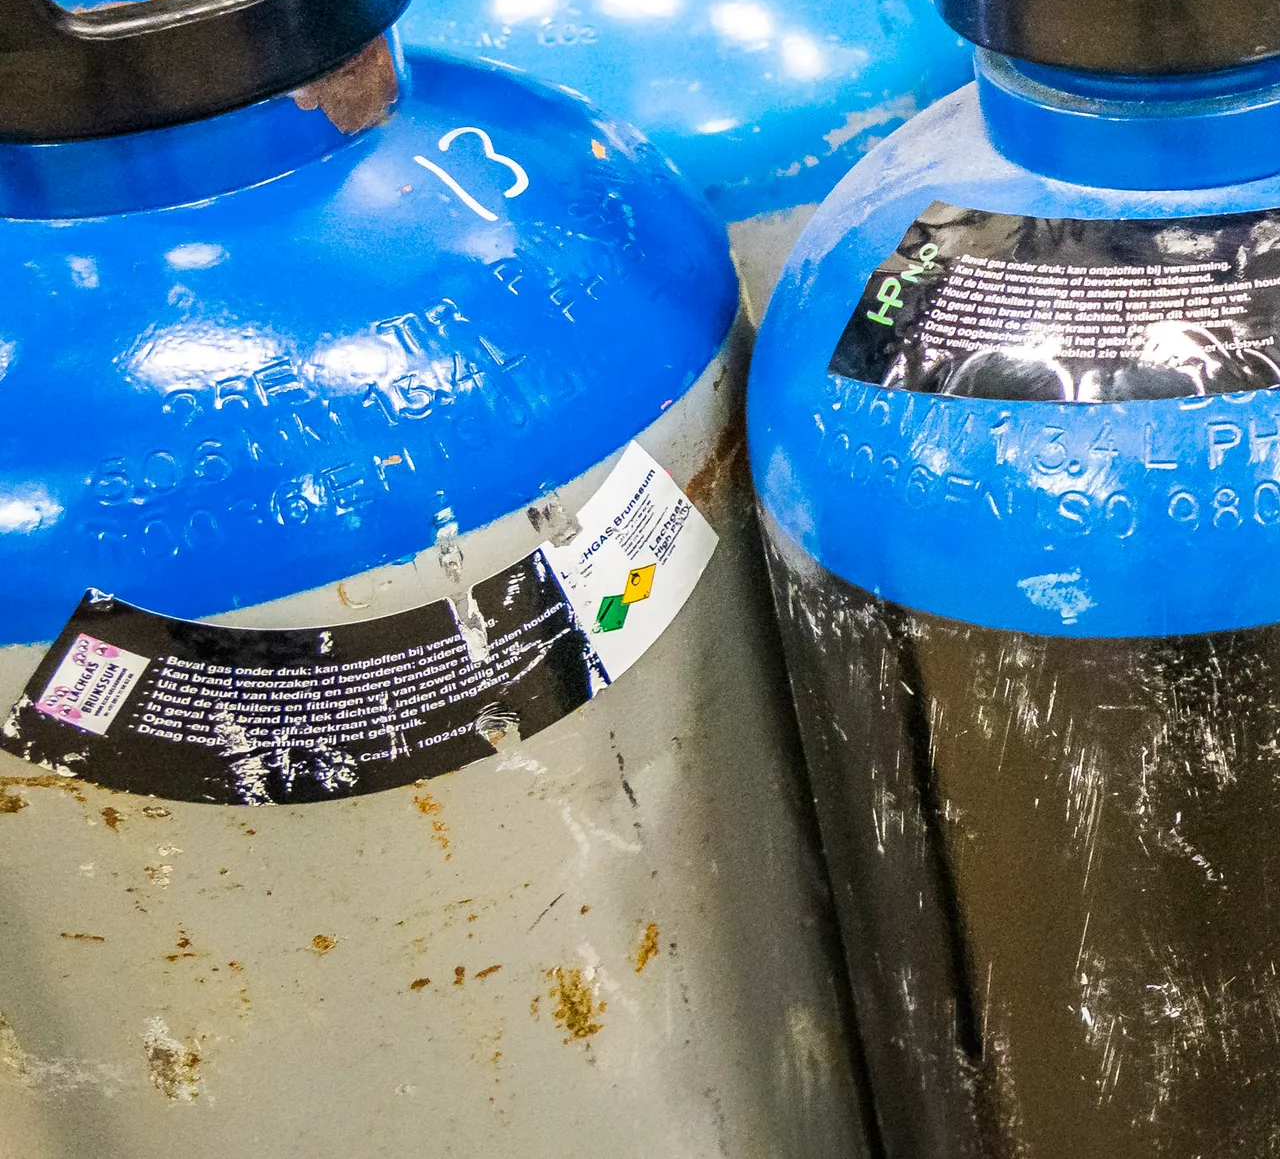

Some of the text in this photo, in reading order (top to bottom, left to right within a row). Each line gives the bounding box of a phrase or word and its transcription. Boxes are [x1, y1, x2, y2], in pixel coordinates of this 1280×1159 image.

[413, 126, 530, 222] 13
[953, 265, 1214, 287] Kan brand veroorzaken bevorderen; oxiderend.
[988, 259, 1231, 277] gas onder kan ontploffen bij verwarming.
[867, 277, 904, 326] HP
[942, 287, 1184, 311] Houd de afsluiters vrij van zowel
[964, 279, 976, 289] de
[978, 282, 1005, 293] buurt
[1007, 286, 1026, 295] van
[1028, 286, 1068, 299] kleding
[1070, 290, 1084, 298] en
[1087, 289, 1127, 299] andere
[1129, 287, 1189, 298] brandbare
[1191, 282, 1252, 295] materialen
[930, 309, 958, 322] Open
[978, 304, 1248, 321] van brand indien kan.
[924, 322, 956, 336] Draag
[613, 469, 656, 527] Brunssum
[649, 498, 684, 551] Lachgas
[157, 602, 567, 701] Uit de buurt van kleding en andere brandbare houden.
[166, 646, 424, 677] Bevat gas onder kan ontploffen bij
[67, 661, 99, 702] LACHGAS
[81, 663, 120, 713] BRUNSSUM
[147, 654, 522, 725] In geval brand het lek dichten, indien dit veilig kan.
[160, 661, 416, 689] Kan brand veroorzaken of bevorderen;
[142, 713, 182, 729] Open
[250, 726, 269, 736] de
[371, 713, 397, 730] van
[401, 705, 418, 717] de
[421, 700, 446, 713] fles
[449, 671, 510, 704] langzaam
[151, 672, 455, 713] Houd de afsluiters en fittingen vrij van zowel
[137, 719, 427, 742] Draag het gebruik.
[417, 723, 475, 749] 1002497
